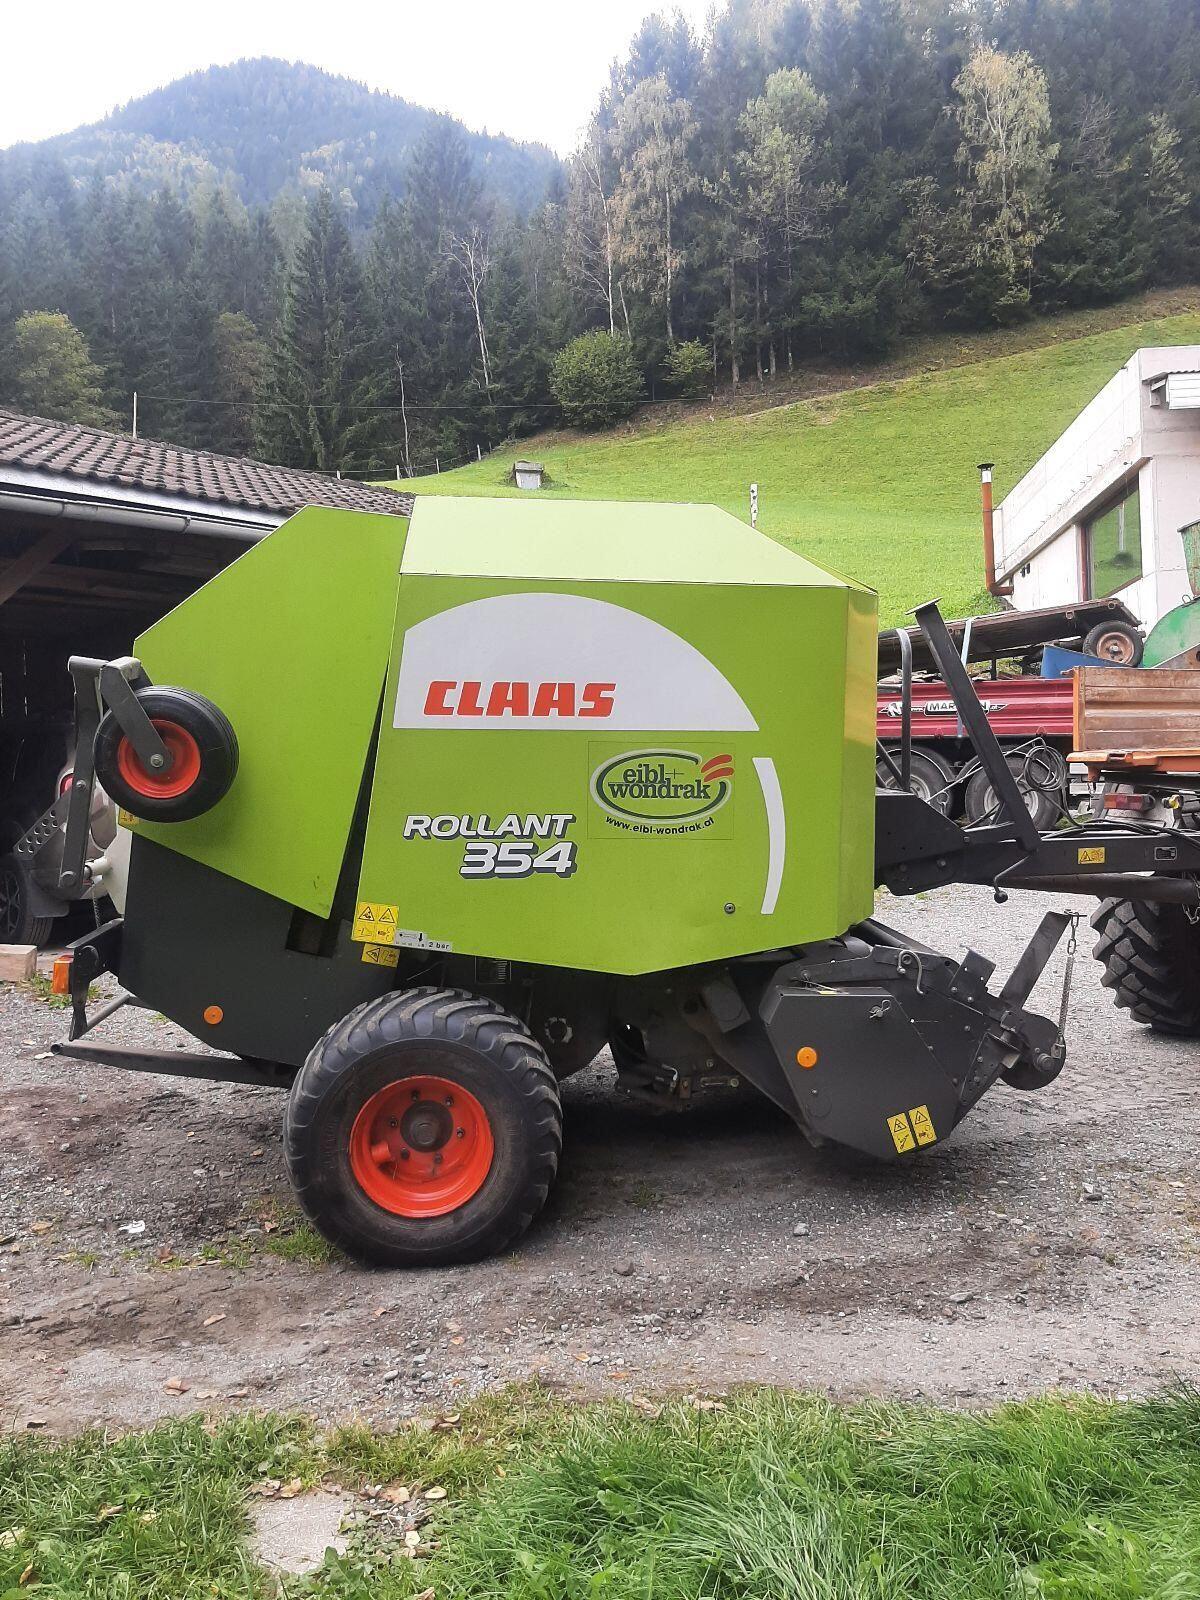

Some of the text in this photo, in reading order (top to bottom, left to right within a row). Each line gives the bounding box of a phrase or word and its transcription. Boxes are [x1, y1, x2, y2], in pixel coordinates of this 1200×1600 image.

[424, 680, 616, 717] CLAAS
[608, 778, 711, 799] wondrak
[403, 814, 576, 840] ROLLANT
[605, 816, 714, 835] www.eibl-wondrak.at
[459, 842, 578, 879] 354
[436, 942, 450, 950] bar
